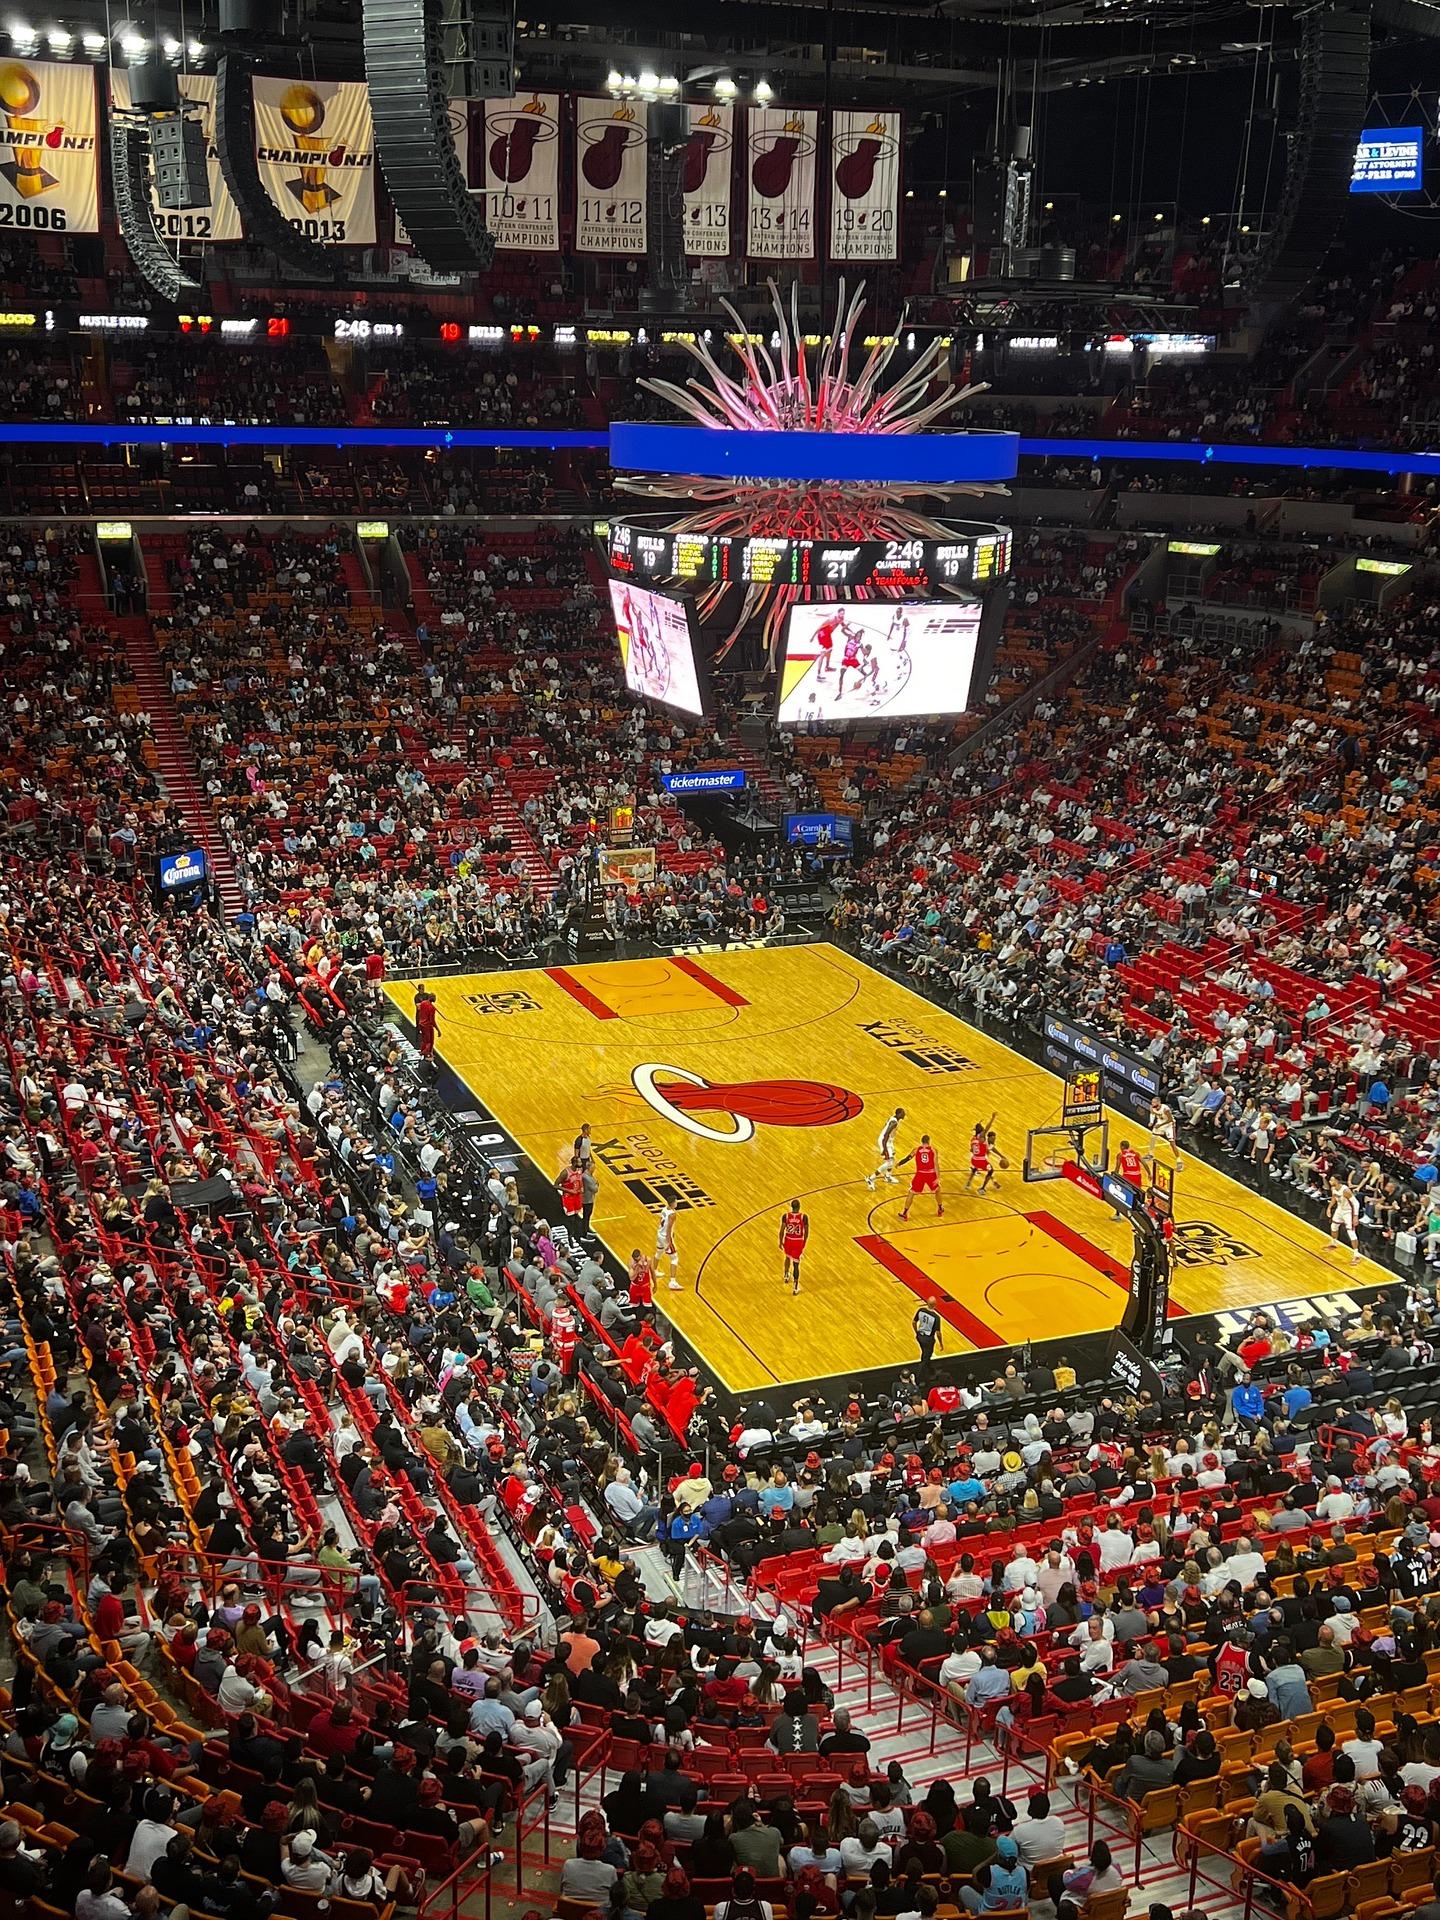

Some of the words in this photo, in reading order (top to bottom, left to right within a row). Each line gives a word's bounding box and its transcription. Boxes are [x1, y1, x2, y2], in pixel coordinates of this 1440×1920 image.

[1371, 148, 1379, 157] &
[1380, 146, 1418, 157] LEVINE
[1369, 160, 1417, 169] ATTORNEYS
[491, 194, 514, 218] 10
[533, 197, 552, 220] 11
[582, 199, 601, 222] 11
[621, 201, 642, 224] 12
[706, 204, 726, 227] 13
[0, 203, 66, 230] 2006
[153, 213, 211, 238] 2012
[751, 208, 771, 230] 13
[790, 209, 809, 231] 14
[835, 209, 854, 231] 19
[872, 209, 893, 231] 20
[494, 231, 554, 245] HAMPIONS
[580, 235, 644, 249] CHAMPIONS
[751, 242, 810, 254] CHAMPIONS
[835, 243, 893, 255] CHAMPIONS
[79, 315, 118, 327] HUSTLE
[119, 317, 149, 328] STATS
[268, 318, 289, 336] 21
[334, 319, 370, 337] 2:46
[373, 323, 394, 335] QTR
[440, 322, 462, 342] 19
[468, 325, 504, 339] BULLS
[637, 535, 666, 552] BULLS
[886, 540, 923, 560] 2:46
[937, 545, 969, 560] BULLS
[642, 550, 656, 567] 19
[876, 560, 911, 569] QUARTER
[827, 561, 847, 578] 21
[891, 568, 906, 577] TOL
[944, 560, 959, 576] 19
[876, 577, 896, 585] TEAM
[896, 577, 920, 585] FOULS
[670, 775, 735, 788] ticketmaster
[163, 865, 200, 885] Corona
[672, 940, 767, 956] HEAT
[855, 1020, 916, 1048] FTX
[888, 1018, 939, 1043] arena
[1048, 1023, 1069, 1043] Corona
[1074, 1038, 1097, 1058] Corona
[1102, 1053, 1126, 1075] Corona
[1076, 1072, 1099, 1085] 2:46
[1131, 1069, 1156, 1091] Corona
[1075, 1104, 1101, 1114] TISSOT
[590, 1137, 649, 1176] FTX
[626, 1134, 678, 1171] arena
[921, 1152, 930, 1164] 9
[786, 1223, 801, 1236] 24
[1132, 1273, 1140, 1298] AT&T
[1115, 1350, 1141, 1377] Florida
[1411, 1568, 1428, 1587] 14
[1219, 1669, 1244, 1693] 23
[1299, 1852, 1315, 1872] 14
